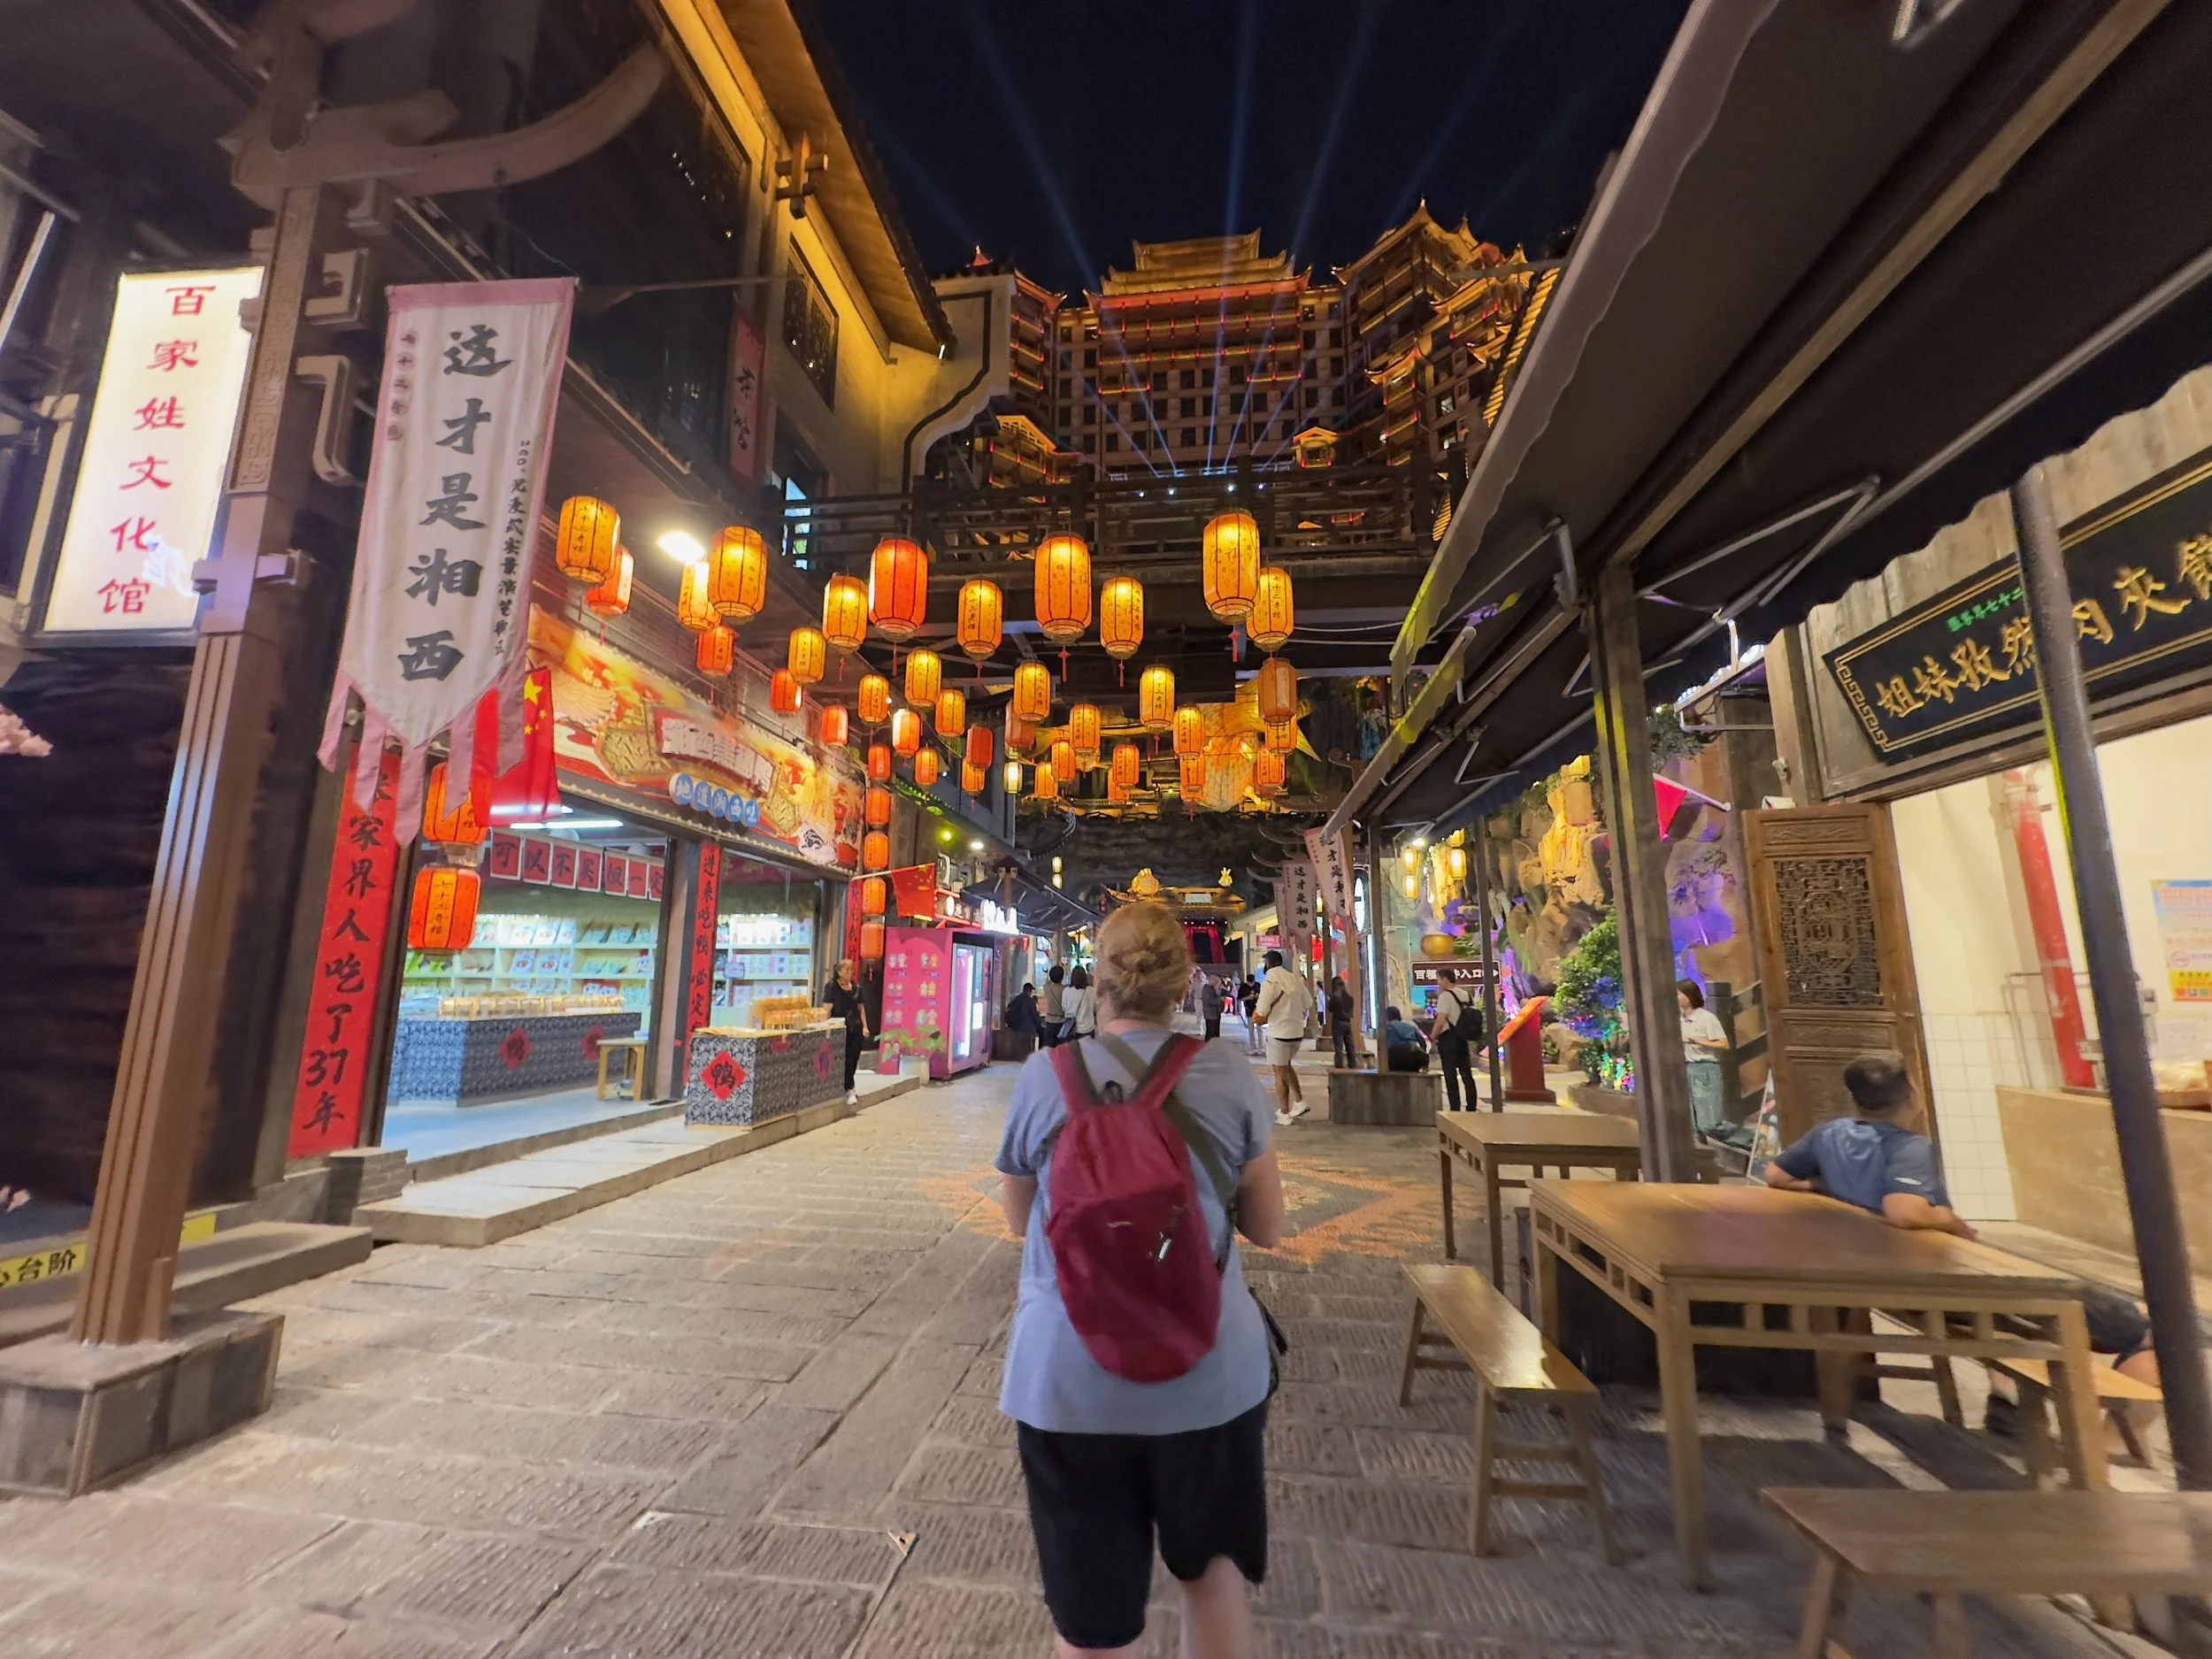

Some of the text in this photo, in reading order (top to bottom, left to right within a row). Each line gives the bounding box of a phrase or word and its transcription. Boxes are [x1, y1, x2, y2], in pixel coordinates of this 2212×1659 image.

[96, 285, 216, 615] 百家姓文化馆
[396, 323, 512, 682] 这才是湘西
[711, 1062, 735, 1089] 鸭
